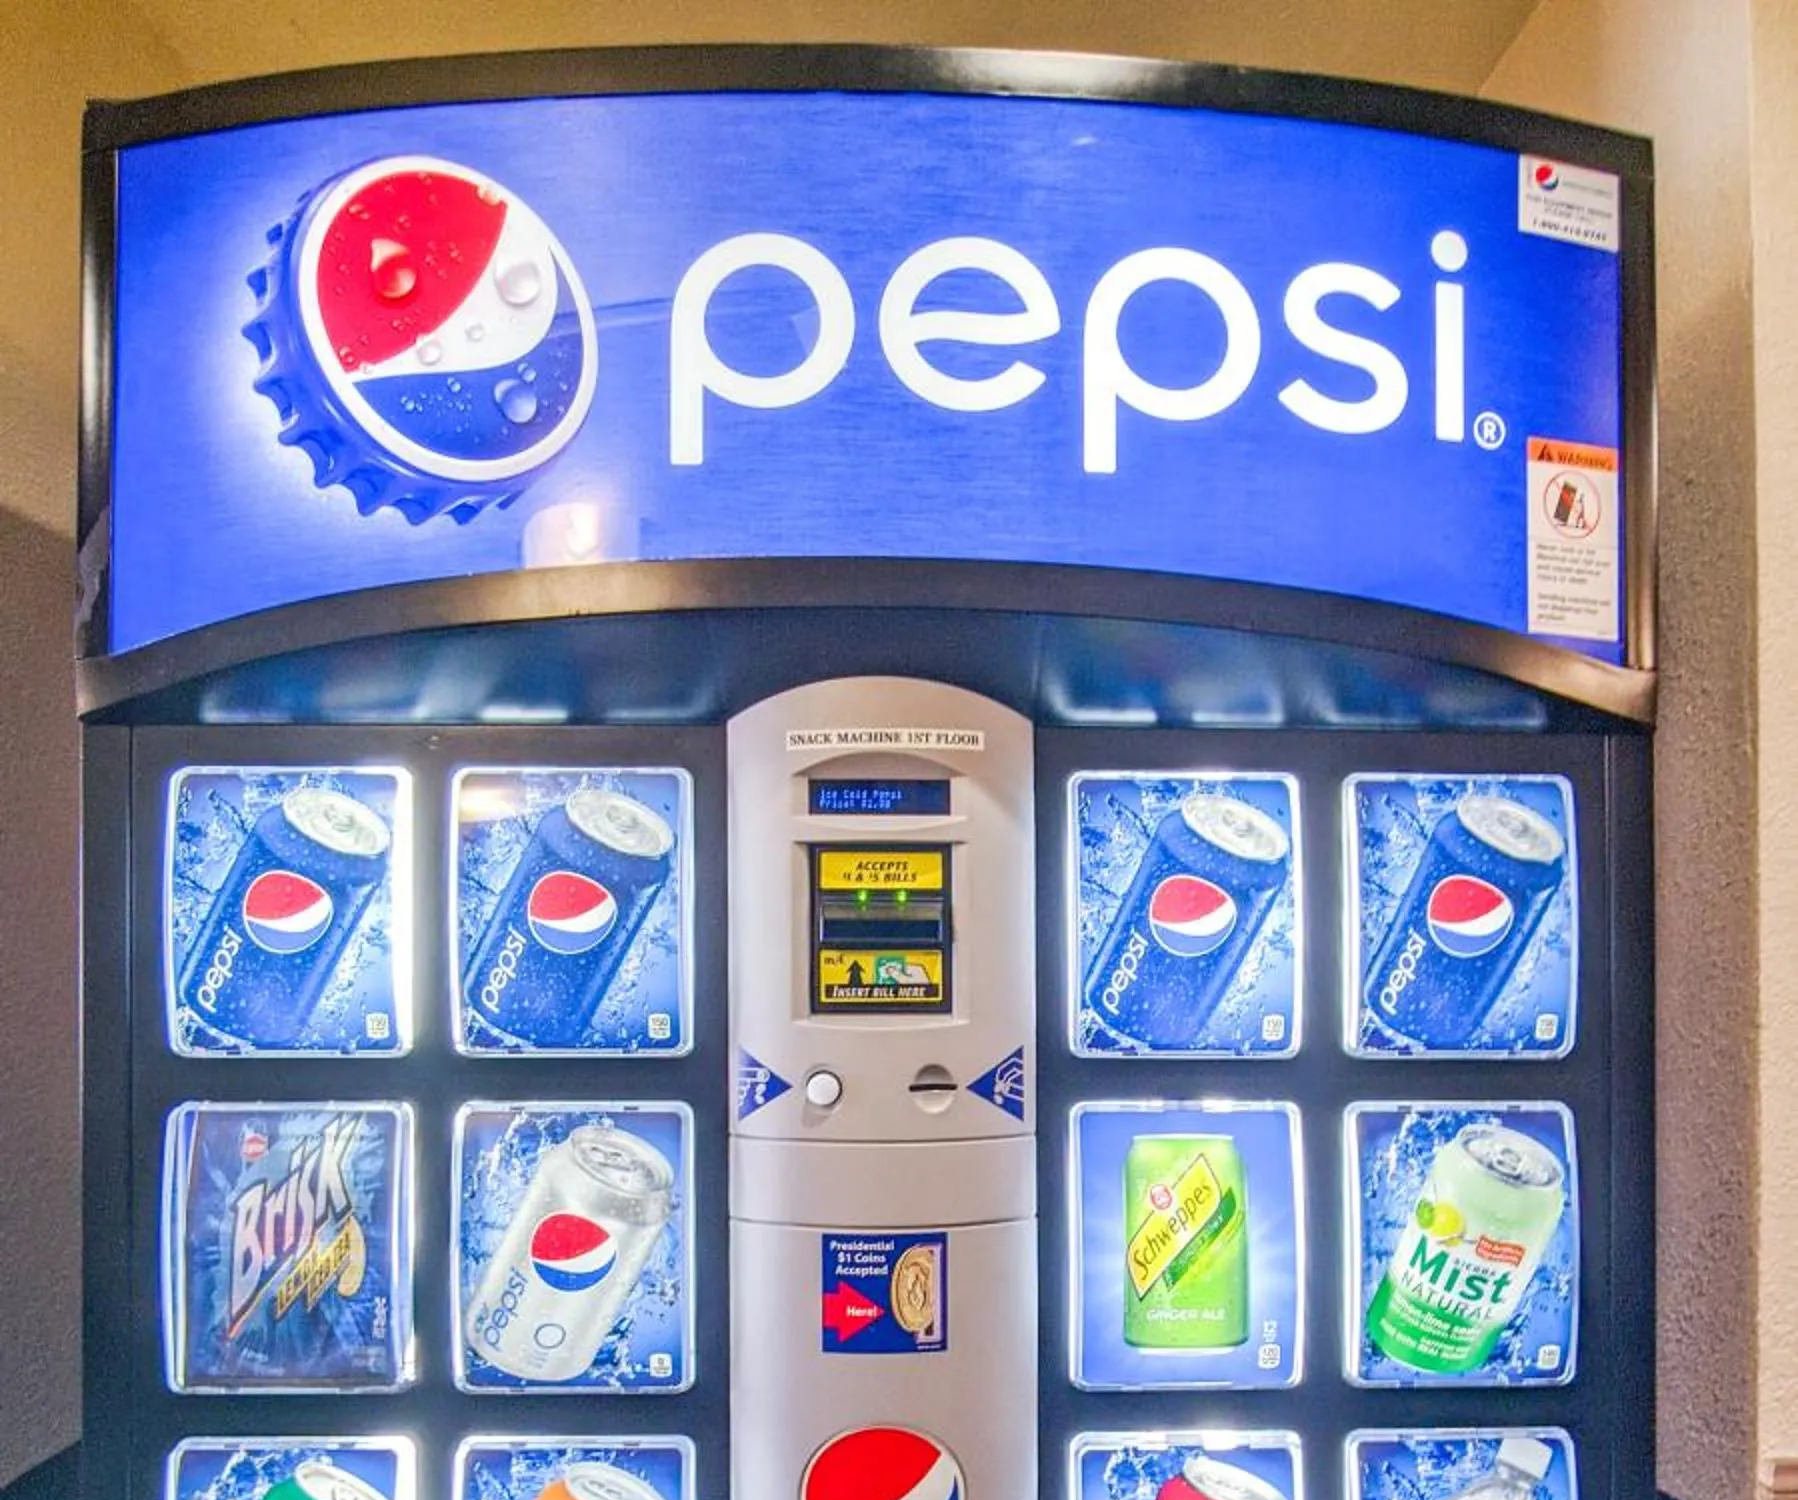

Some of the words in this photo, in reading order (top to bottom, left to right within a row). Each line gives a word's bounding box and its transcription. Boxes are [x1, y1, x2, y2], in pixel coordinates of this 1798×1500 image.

[670, 229, 1468, 473] pepsi
[789, 733, 833, 745] SNACK
[837, 731, 900, 744] MACHINE
[908, 732, 930, 744] 1ST
[936, 733, 979, 746] FLOOR
[855, 861, 909, 871] ACCEPTS
[884, 873, 917, 882] BILLS
[197, 926, 243, 1013] pepsi
[480, 924, 527, 1014] pepsi
[1102, 927, 1149, 1016] pepsi
[1379, 927, 1426, 1016] pepsi
[832, 985, 870, 997] INSERT
[872, 986, 895, 997] BILL
[897, 986, 927, 997] HERE
[829, 1240, 895, 1251] Presidential
[1133, 1178, 1213, 1282] Schweppes
[835, 1265, 889, 1278] Accepted
[838, 1252, 851, 1263] $1
[854, 1252, 886, 1263] Coins
[1409, 1234, 1512, 1304] Mist
[484, 1266, 529, 1353] pepsi
[846, 1305, 878, 1317] Here!
[1402, 1271, 1494, 1320] NATURAL
[1146, 1308, 1198, 1321] GINGER
[1201, 1309, 1225, 1321] ALE
